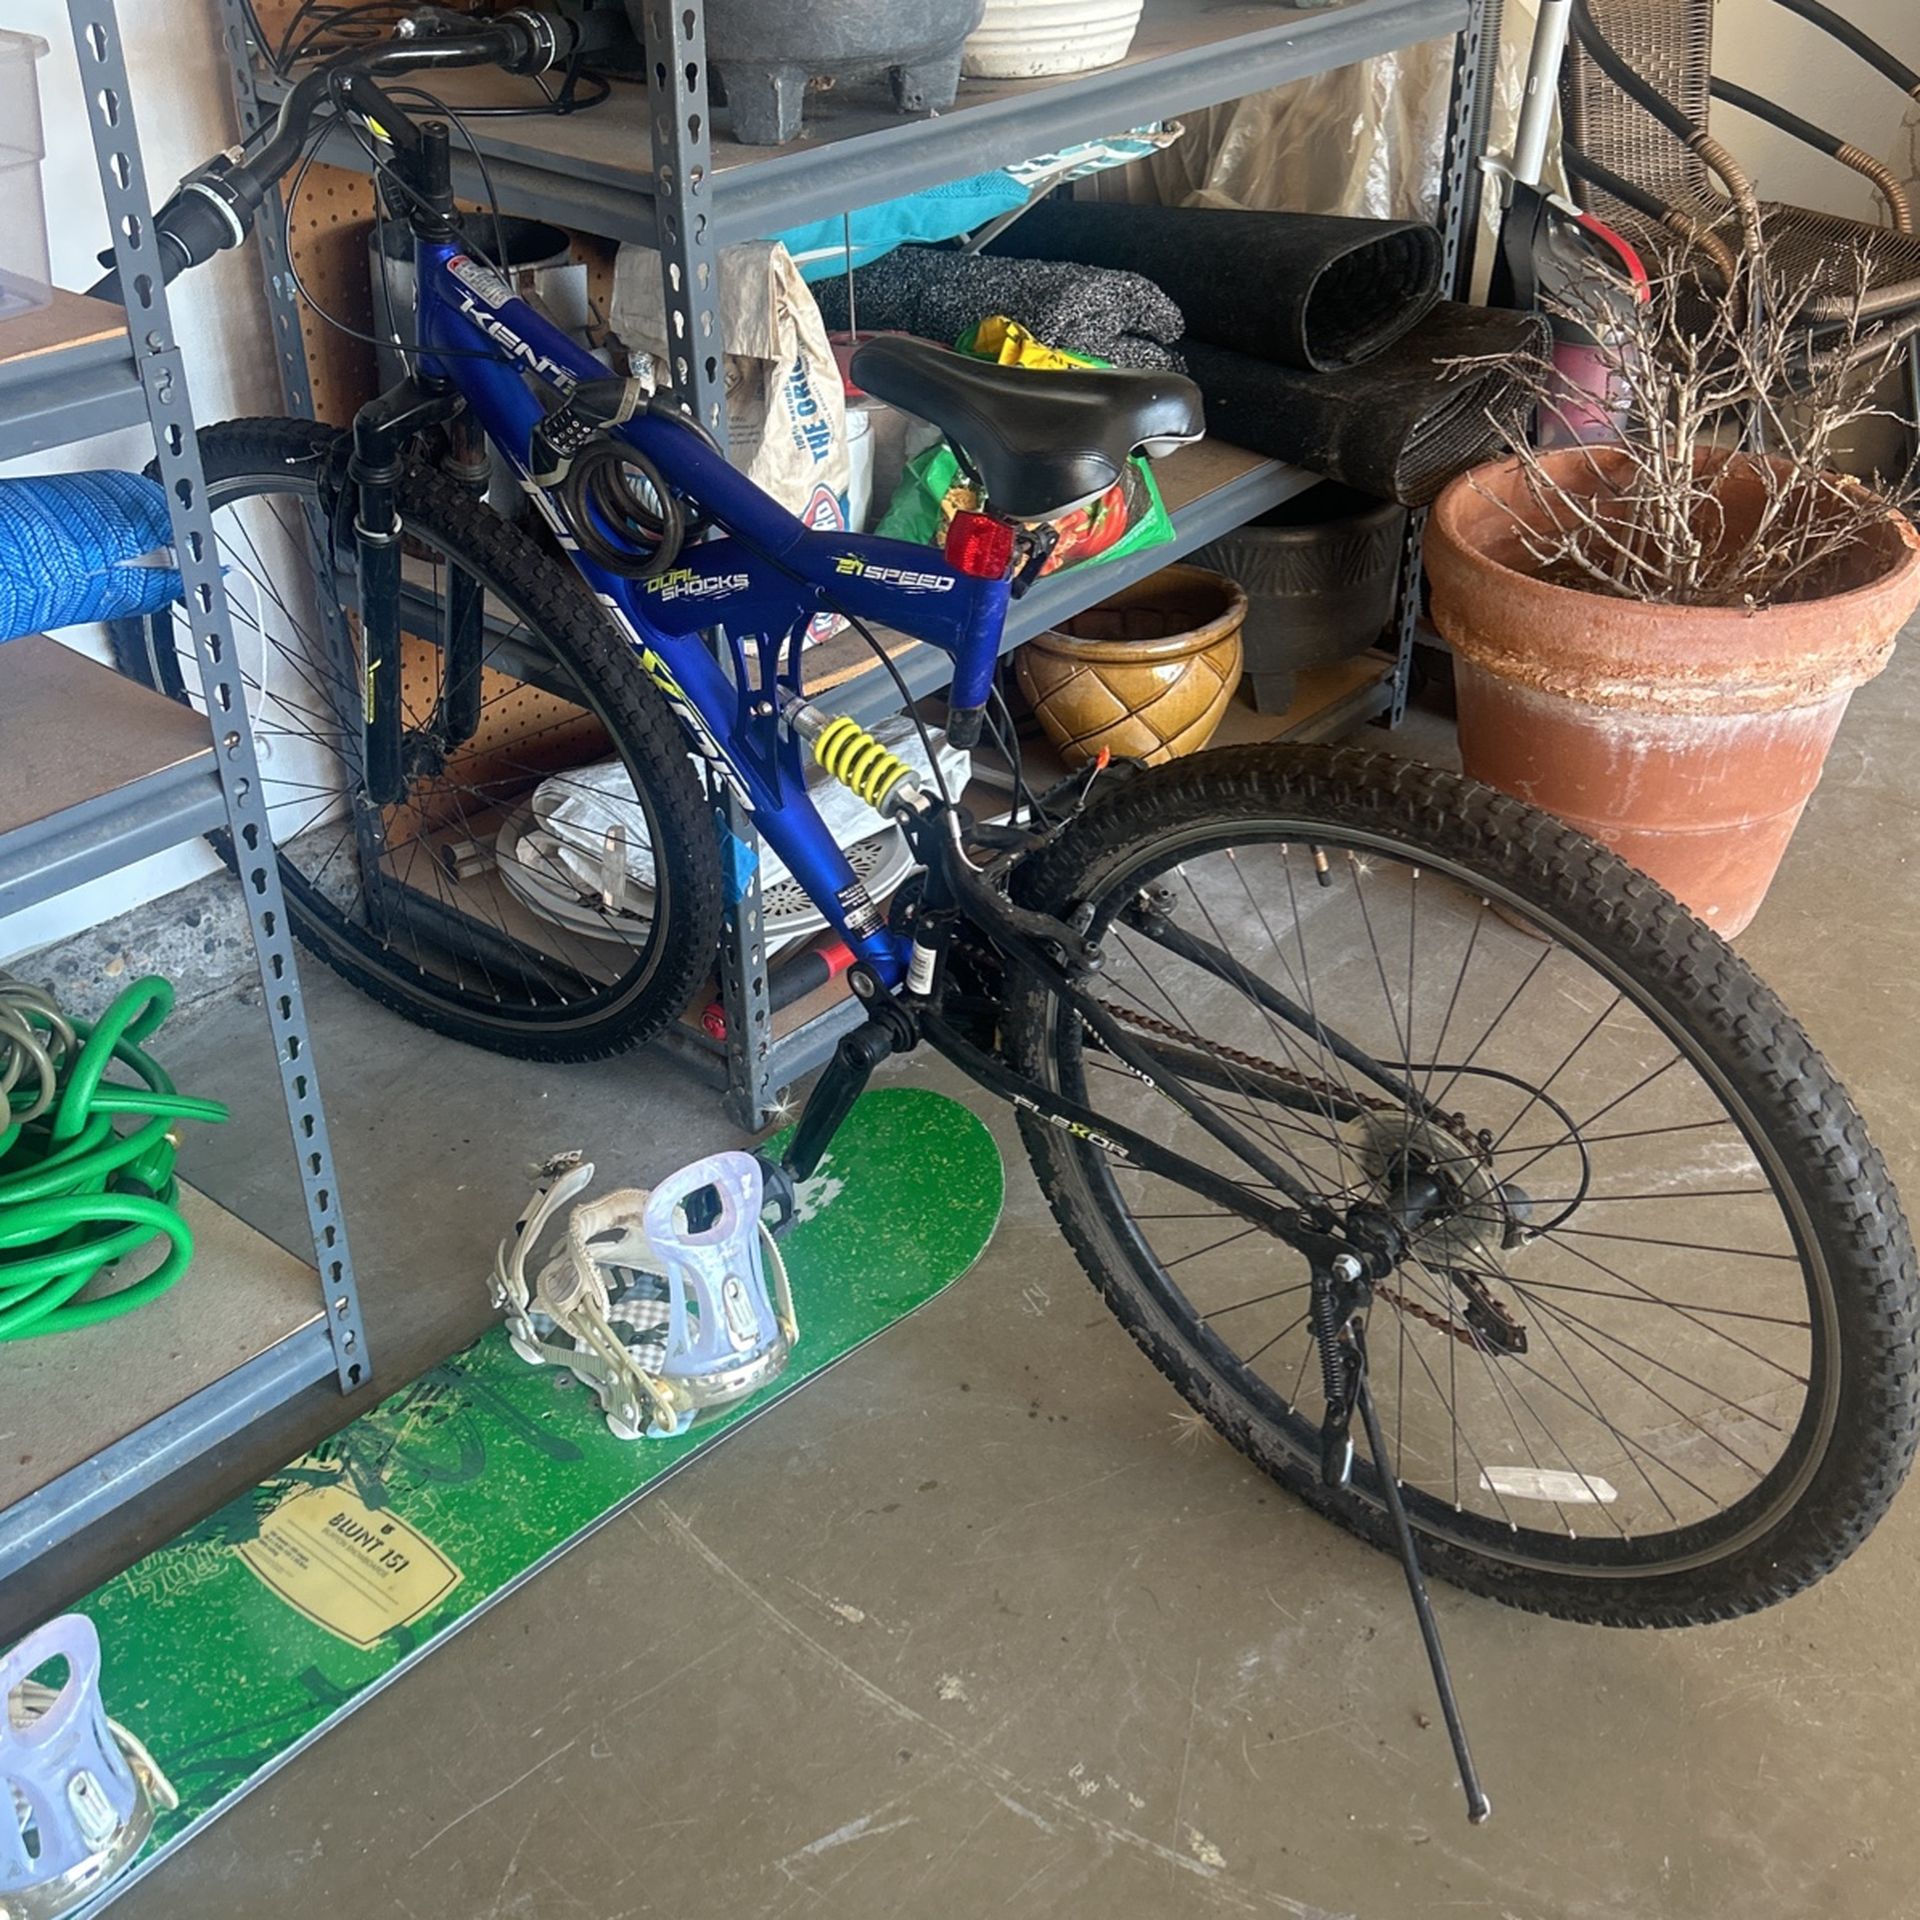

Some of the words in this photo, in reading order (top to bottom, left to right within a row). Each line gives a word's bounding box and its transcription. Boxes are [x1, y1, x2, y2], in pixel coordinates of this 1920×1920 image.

[459, 297, 579, 397] KENT
[802, 418, 831, 465] THE
[646, 567, 700, 594] DUAL
[661, 574, 749, 602] SHOCKS
[836, 557, 865, 577] 21
[863, 564, 956, 591] SPEED
[1014, 1094, 1130, 1158] FLEXOR
[328, 1512, 385, 1553] BLUNT
[379, 1549, 410, 1574] 151
